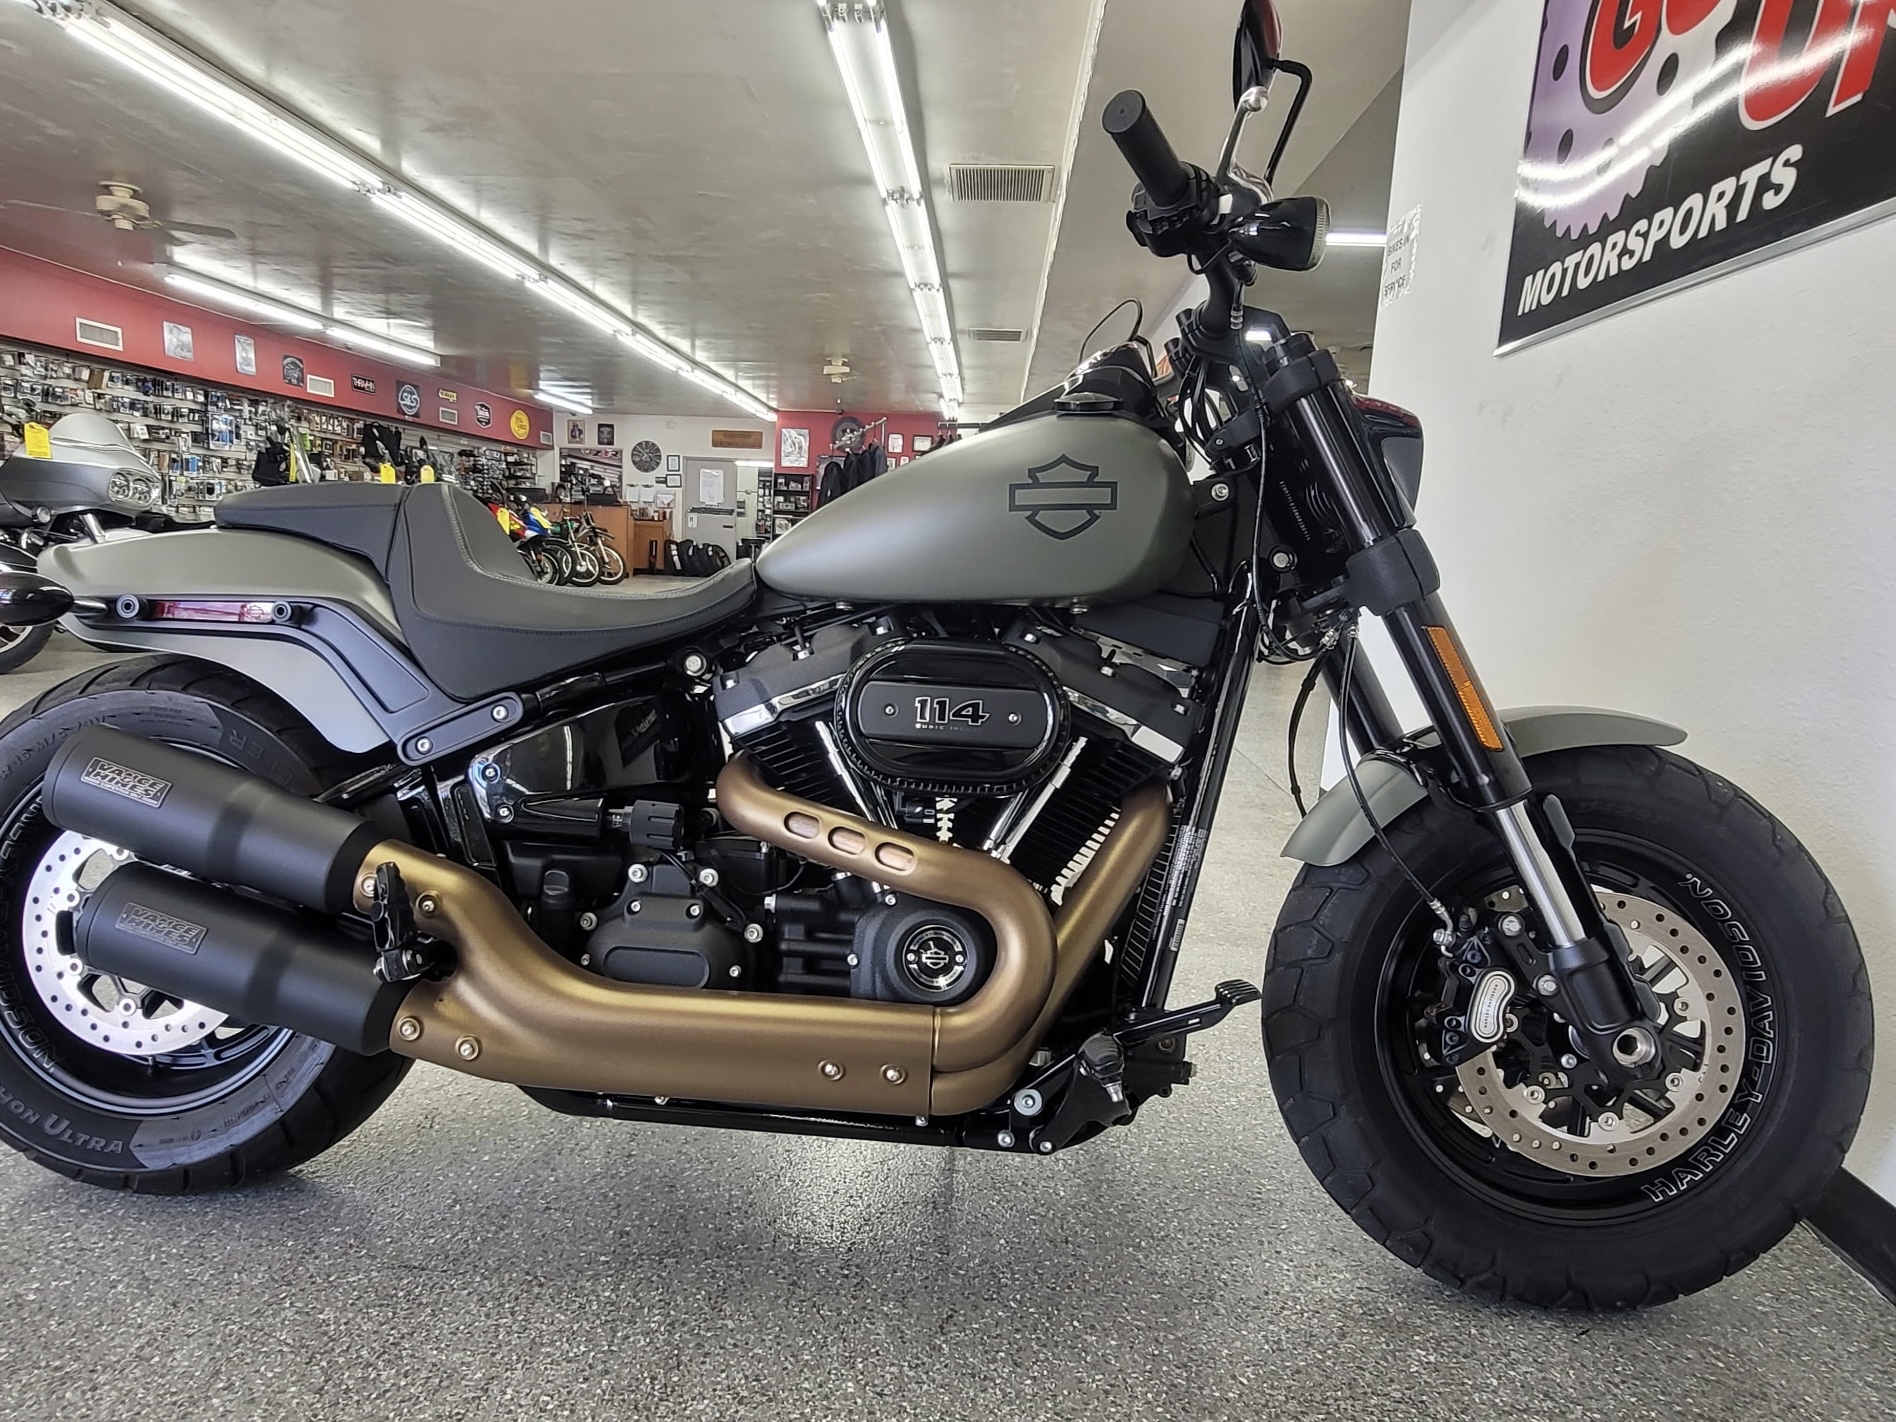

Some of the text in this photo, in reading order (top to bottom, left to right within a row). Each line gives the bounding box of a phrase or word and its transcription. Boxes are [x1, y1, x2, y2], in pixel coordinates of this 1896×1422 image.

[1517, 144, 1803, 316] MOTORSPORTS
[914, 696, 991, 726] 114
[90, 770, 156, 797] HINES
[97, 762, 165, 790] VANCE
[125, 917, 191, 944] HINES
[131, 907, 200, 936] VANCE
[1640, 874, 1775, 1202] HARLEY-DAVIDSON
[44, 1113, 123, 1154] ULTRA
